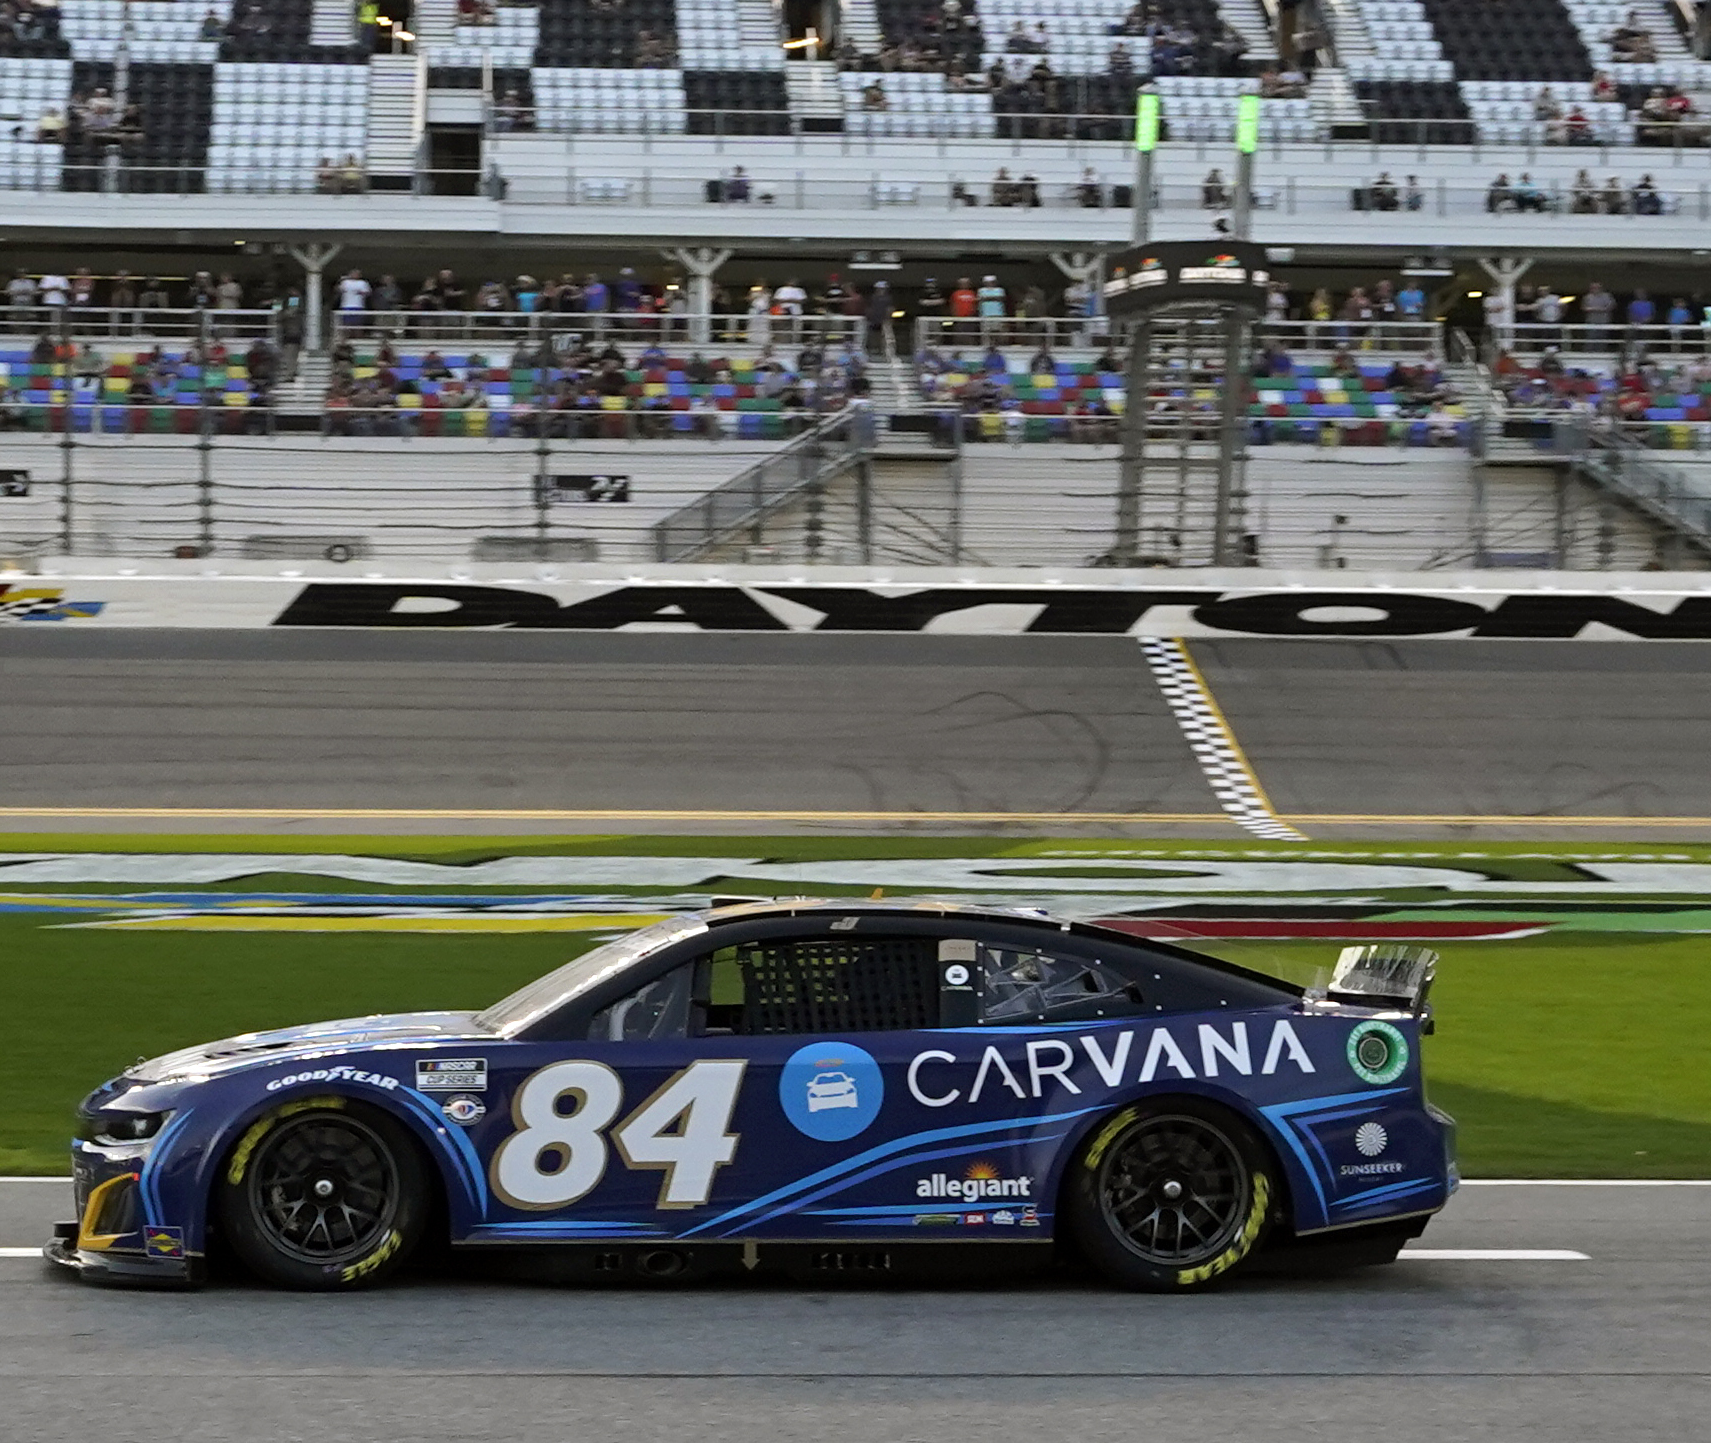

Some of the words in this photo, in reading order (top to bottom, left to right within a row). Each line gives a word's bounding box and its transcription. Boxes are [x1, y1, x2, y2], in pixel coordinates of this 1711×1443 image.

[266, 1066, 400, 1091] GOODYEAR
[906, 1019, 1316, 1108] CARVANA
[490, 1059, 749, 1212] 84
[1340, 1162, 1403, 1176] SUNSEEKER
[916, 1173, 1031, 1203] allegiant
